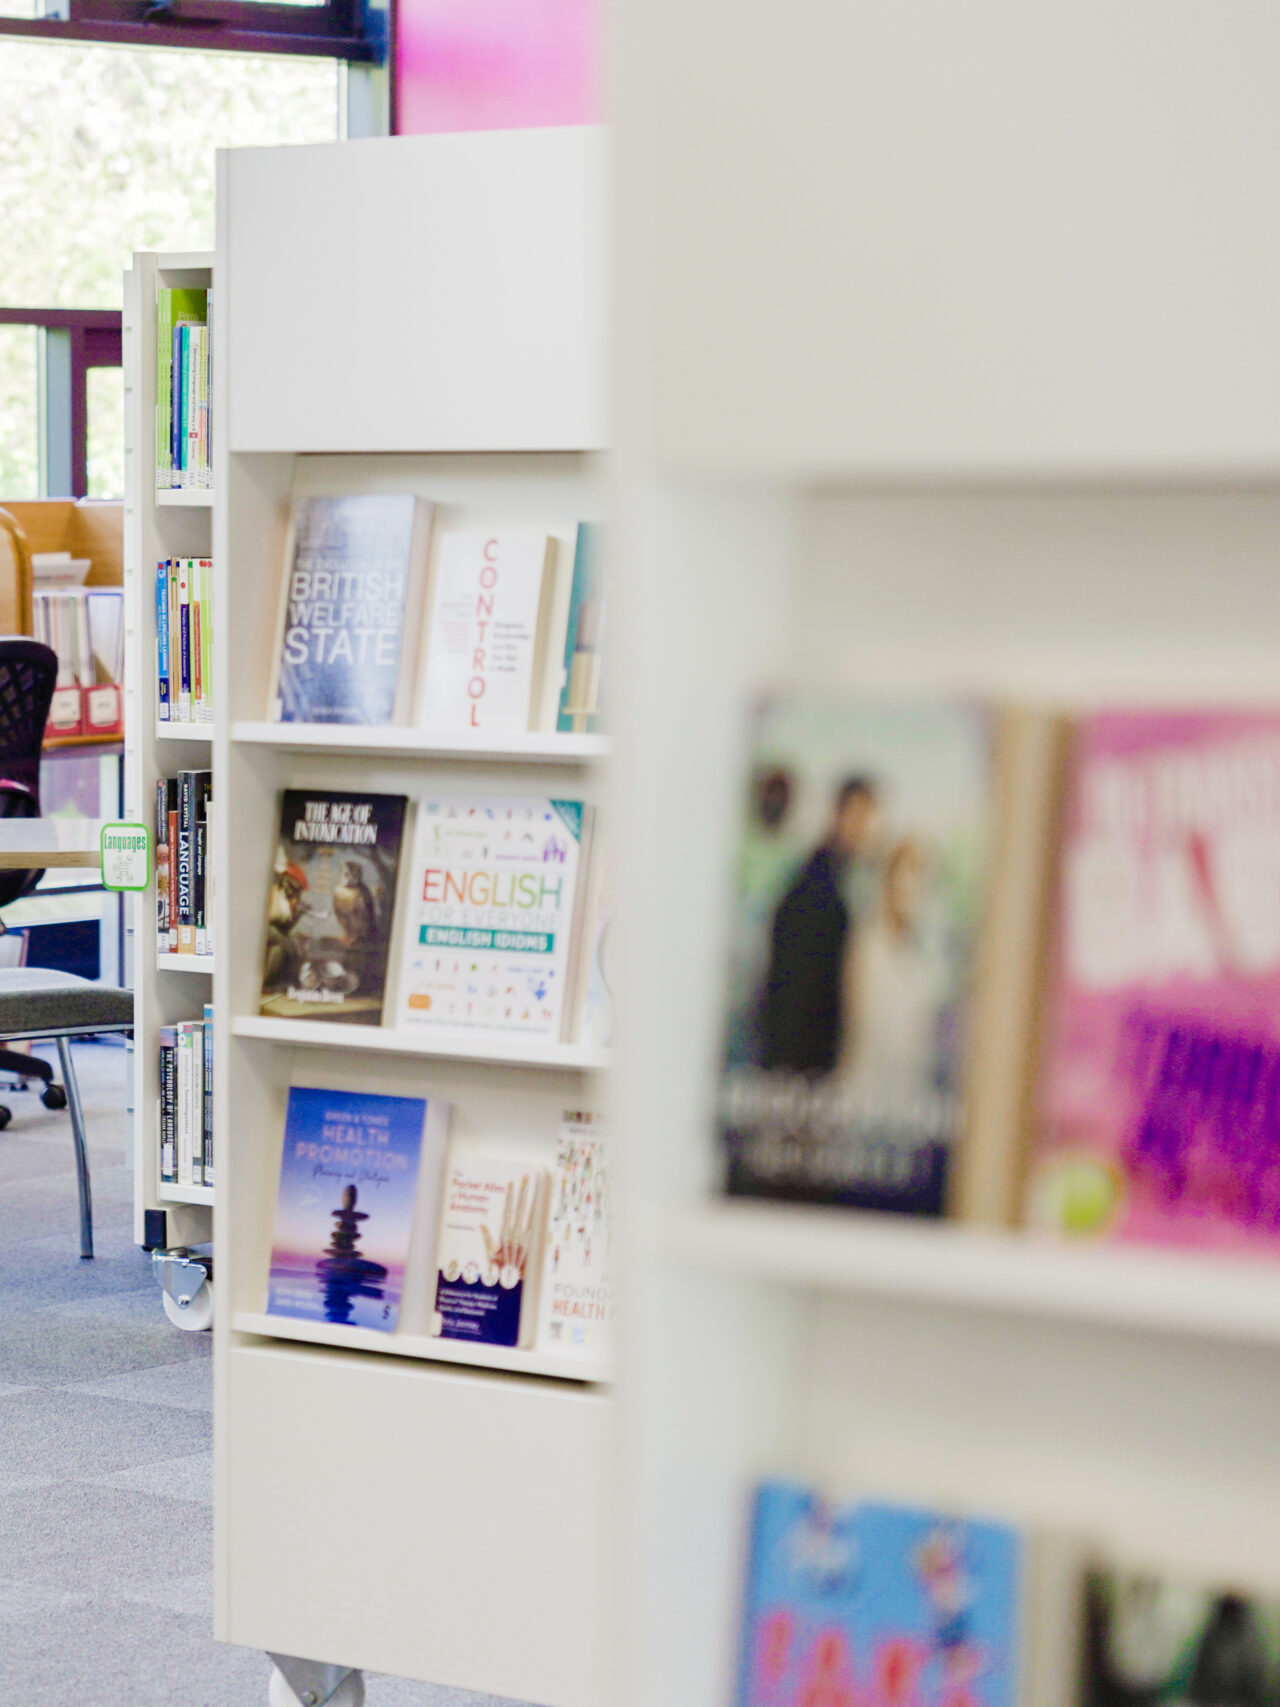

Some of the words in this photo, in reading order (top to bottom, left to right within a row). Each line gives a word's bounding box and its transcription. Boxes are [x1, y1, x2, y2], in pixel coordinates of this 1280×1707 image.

[291, 571, 404, 601] BRITISH
[289, 601, 400, 626] WELFARE
[468, 539, 499, 727] CONTROL
[284, 627, 397, 666] STATE
[305, 802, 329, 821] THE
[331, 803, 353, 823] AGE
[354, 804, 372, 825] OF
[104, 833, 146, 853] Languages
[294, 821, 378, 845] INTOXICATION
[179, 832, 189, 915] LANGUAGE
[422, 869, 563, 910] ENGLISH
[419, 905, 455, 921] FOR
[463, 908, 560, 931] EVERYONE
[426, 927, 492, 946] ENGLISH
[494, 930, 548, 951] IDIOMS
[322, 1125, 389, 1146] HEALTH
[296, 1142, 408, 1169] PROMOTION
[452, 1179, 482, 1190] Pocket
[457, 1191, 489, 1203] Human
[450, 1203, 489, 1216] Anatomy
[554, 1283, 615, 1302] FOUND
[552, 1299, 606, 1321] HEALTH
